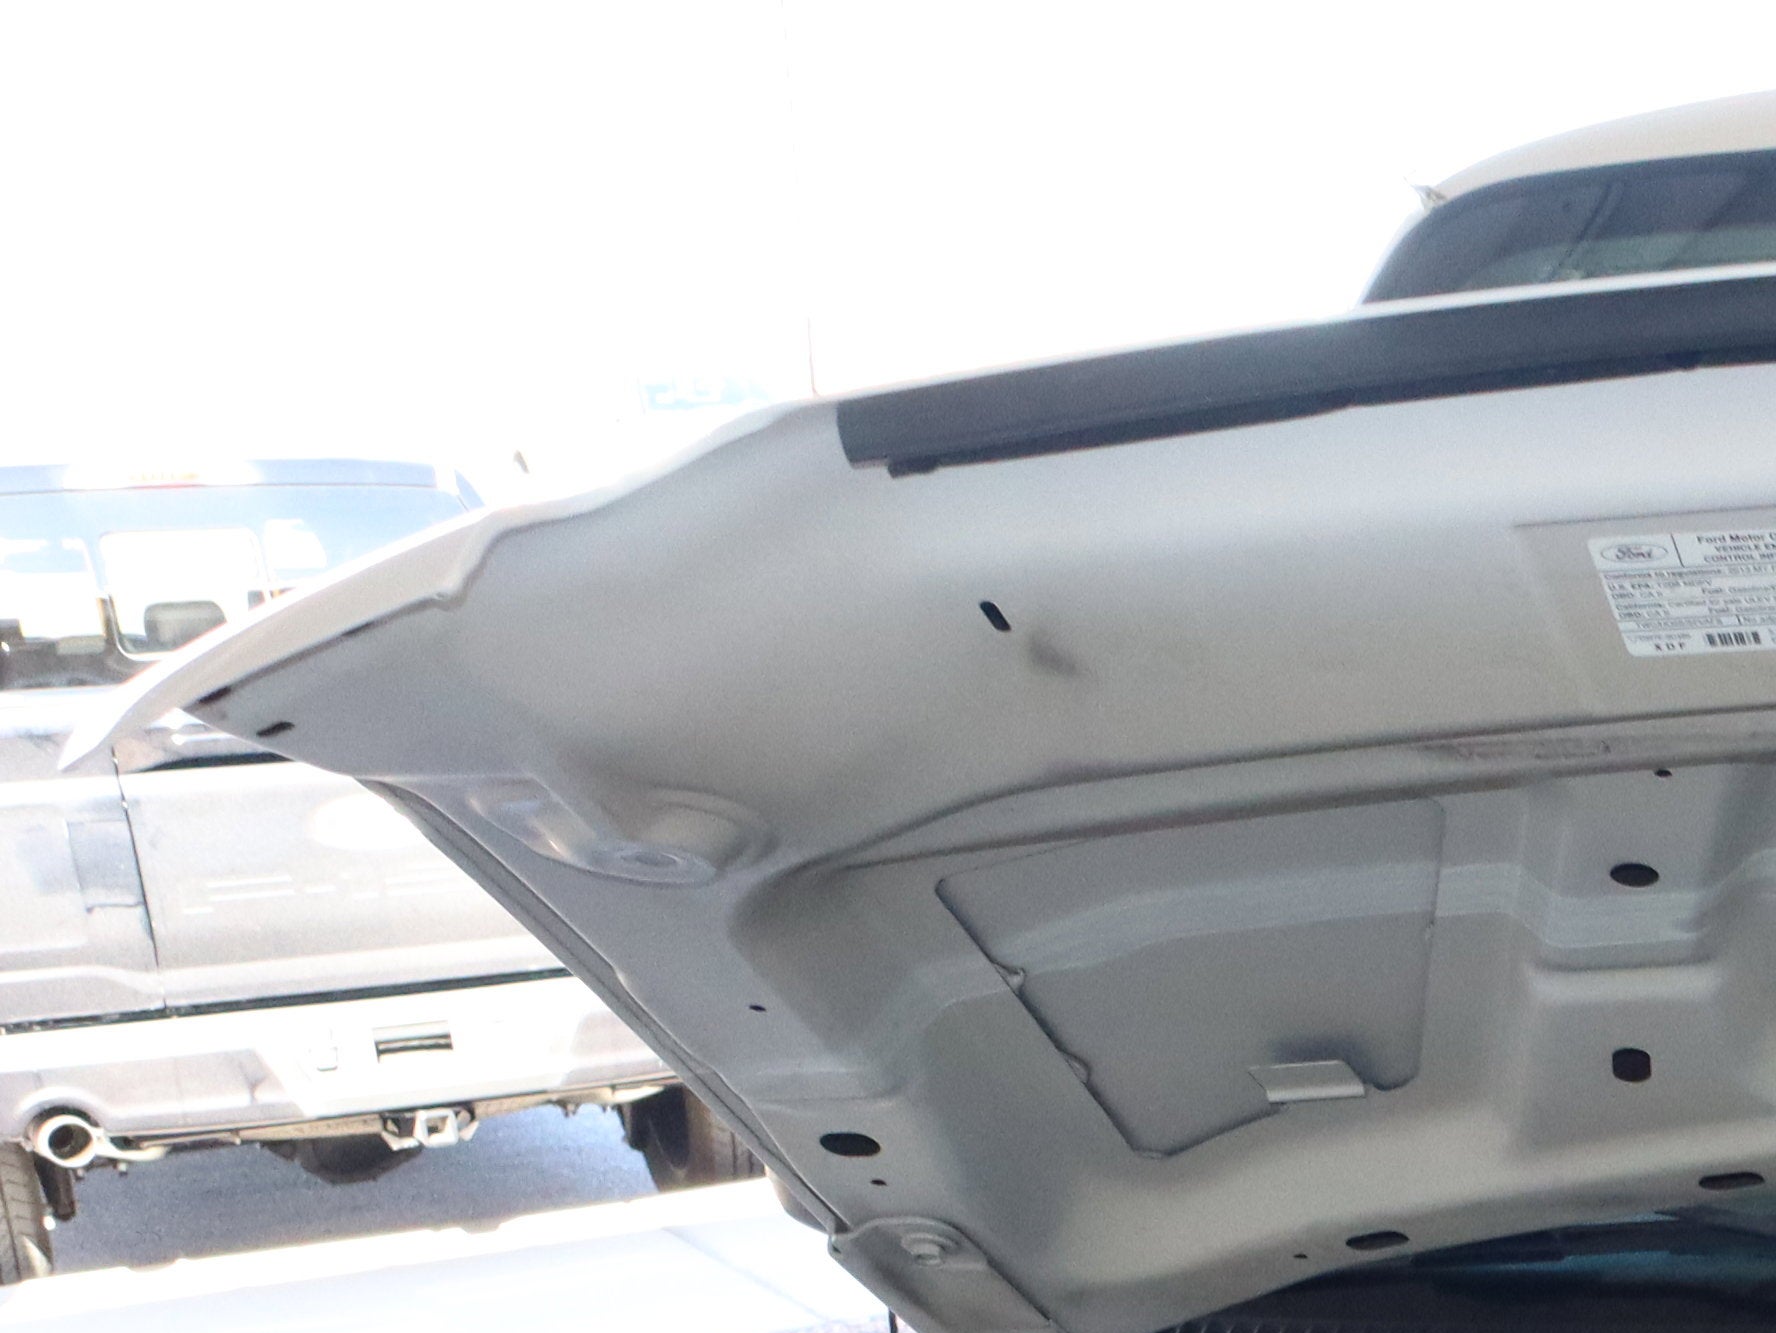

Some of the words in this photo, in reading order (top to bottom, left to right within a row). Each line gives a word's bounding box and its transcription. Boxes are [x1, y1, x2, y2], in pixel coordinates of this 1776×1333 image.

[1695, 534, 1727, 544] Ford
[1728, 532, 1766, 543] Motor
[1713, 543, 1762, 553] VEHICLE
[1702, 553, 1756, 563] CONTROL
